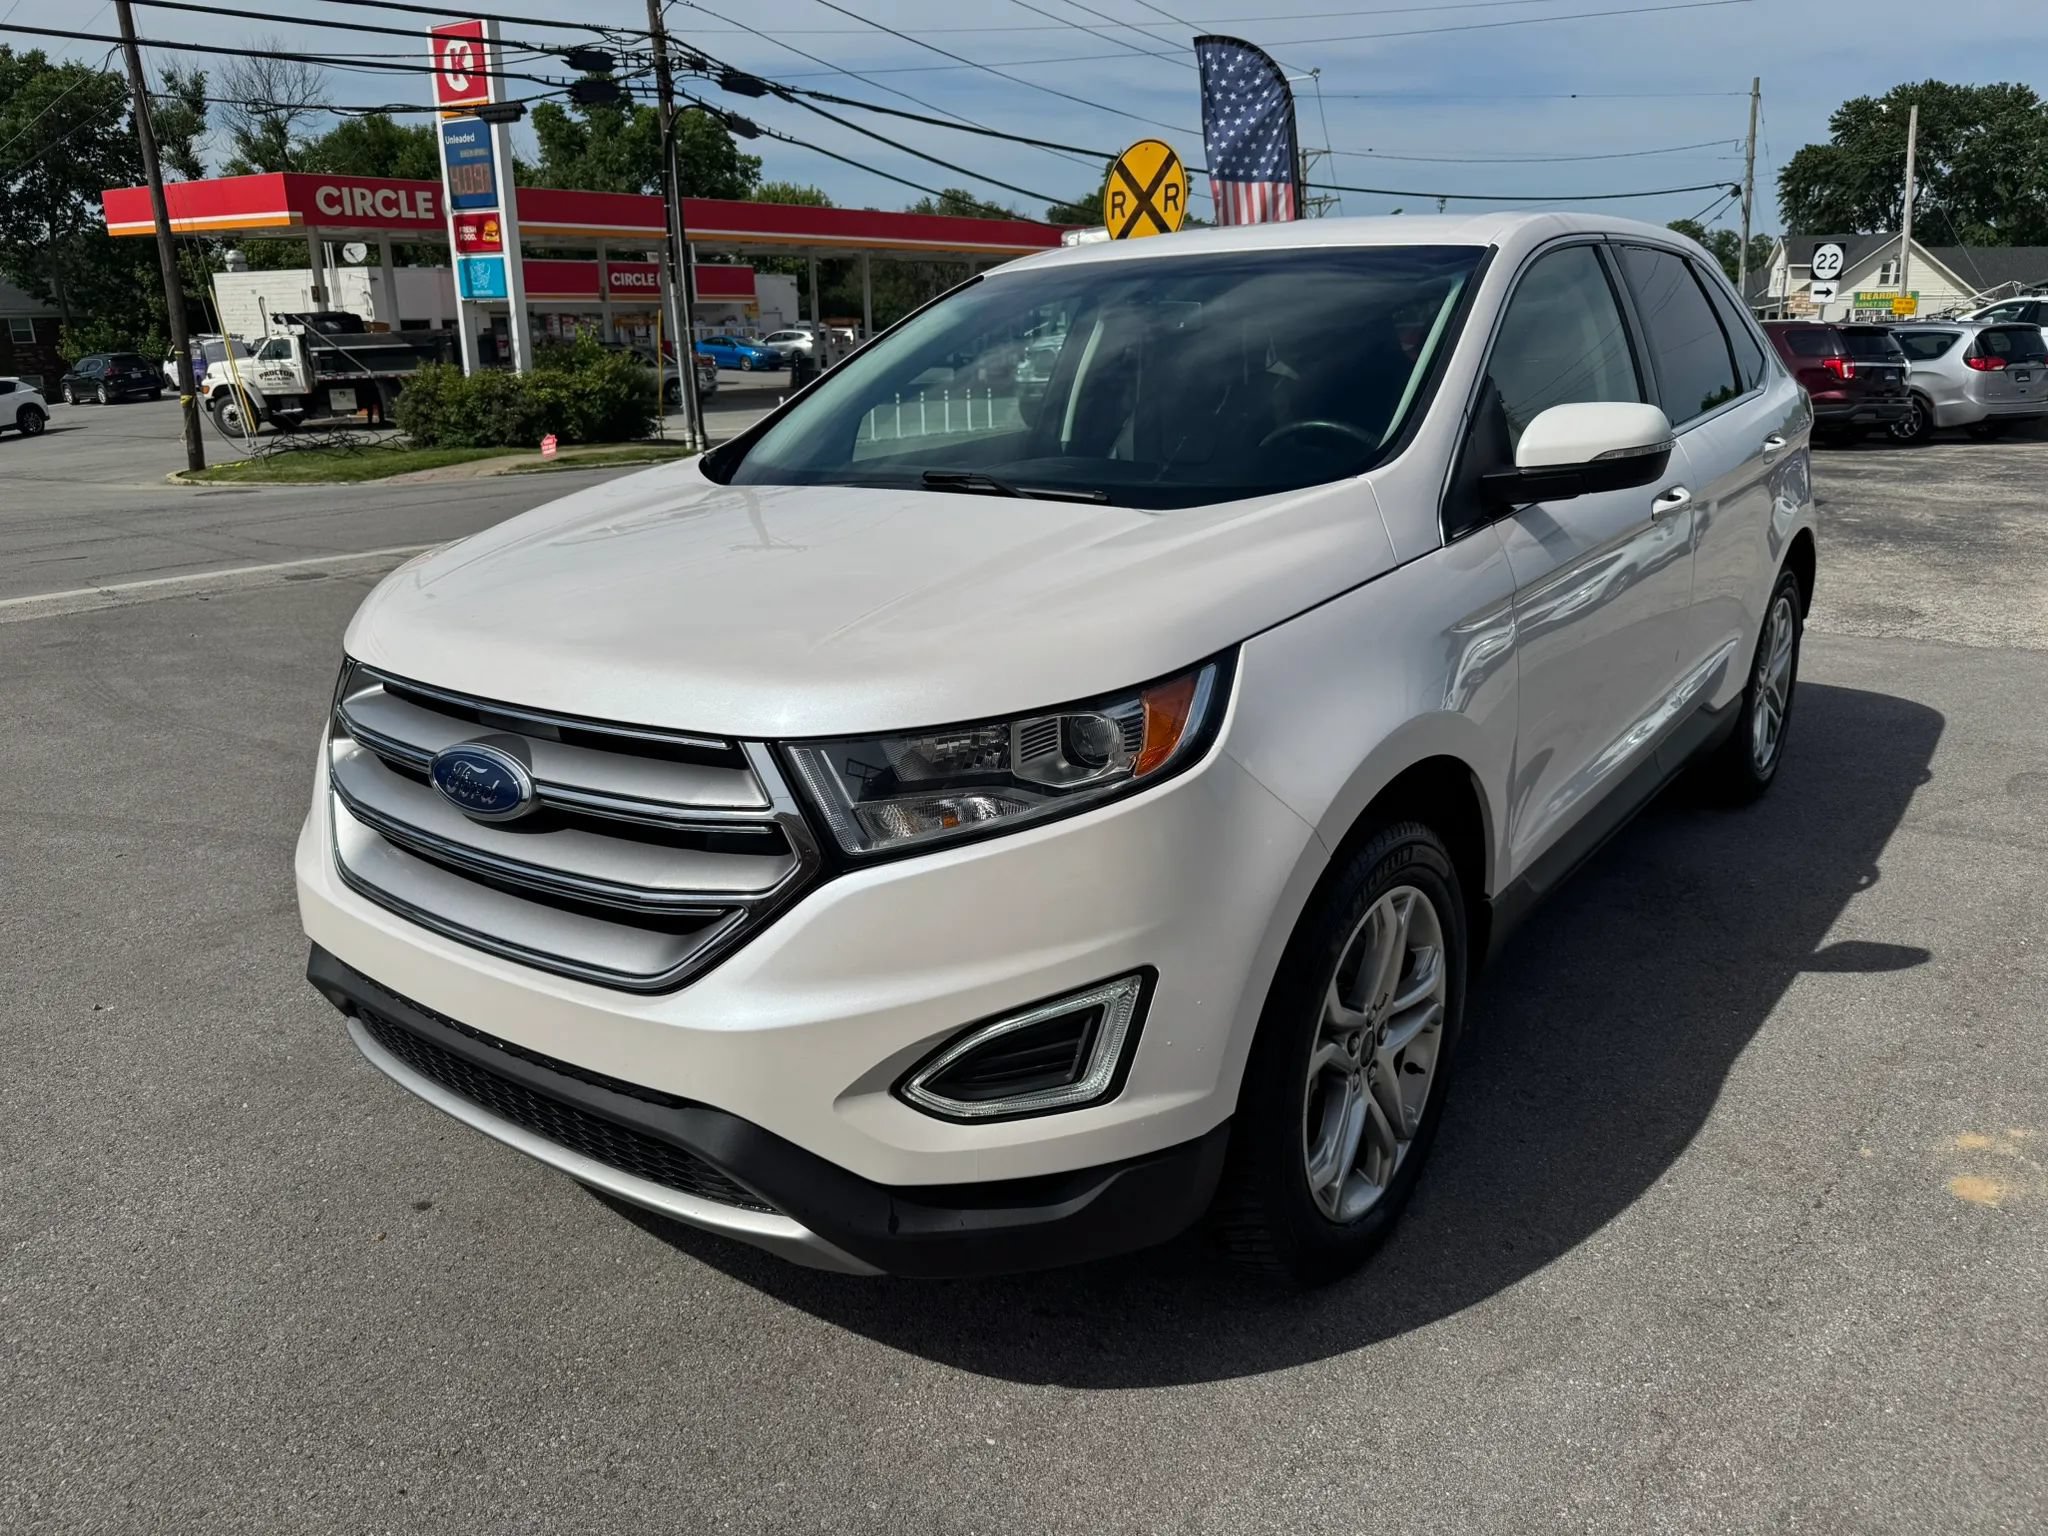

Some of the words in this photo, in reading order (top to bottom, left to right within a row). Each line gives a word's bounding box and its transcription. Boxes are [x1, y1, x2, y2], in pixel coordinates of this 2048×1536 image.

[445, 132, 475, 145] Unleaded
[315, 185, 435, 219] CIRCLE
[1111, 191, 1126, 220] R
[1163, 183, 1180, 213] R
[459, 226, 477, 234] FRESH
[1816, 253, 1839, 270] 22
[611, 272, 656, 286] CIRCLE
[259, 370, 295, 380] PROCTOR
[446, 760, 500, 804] Ford
